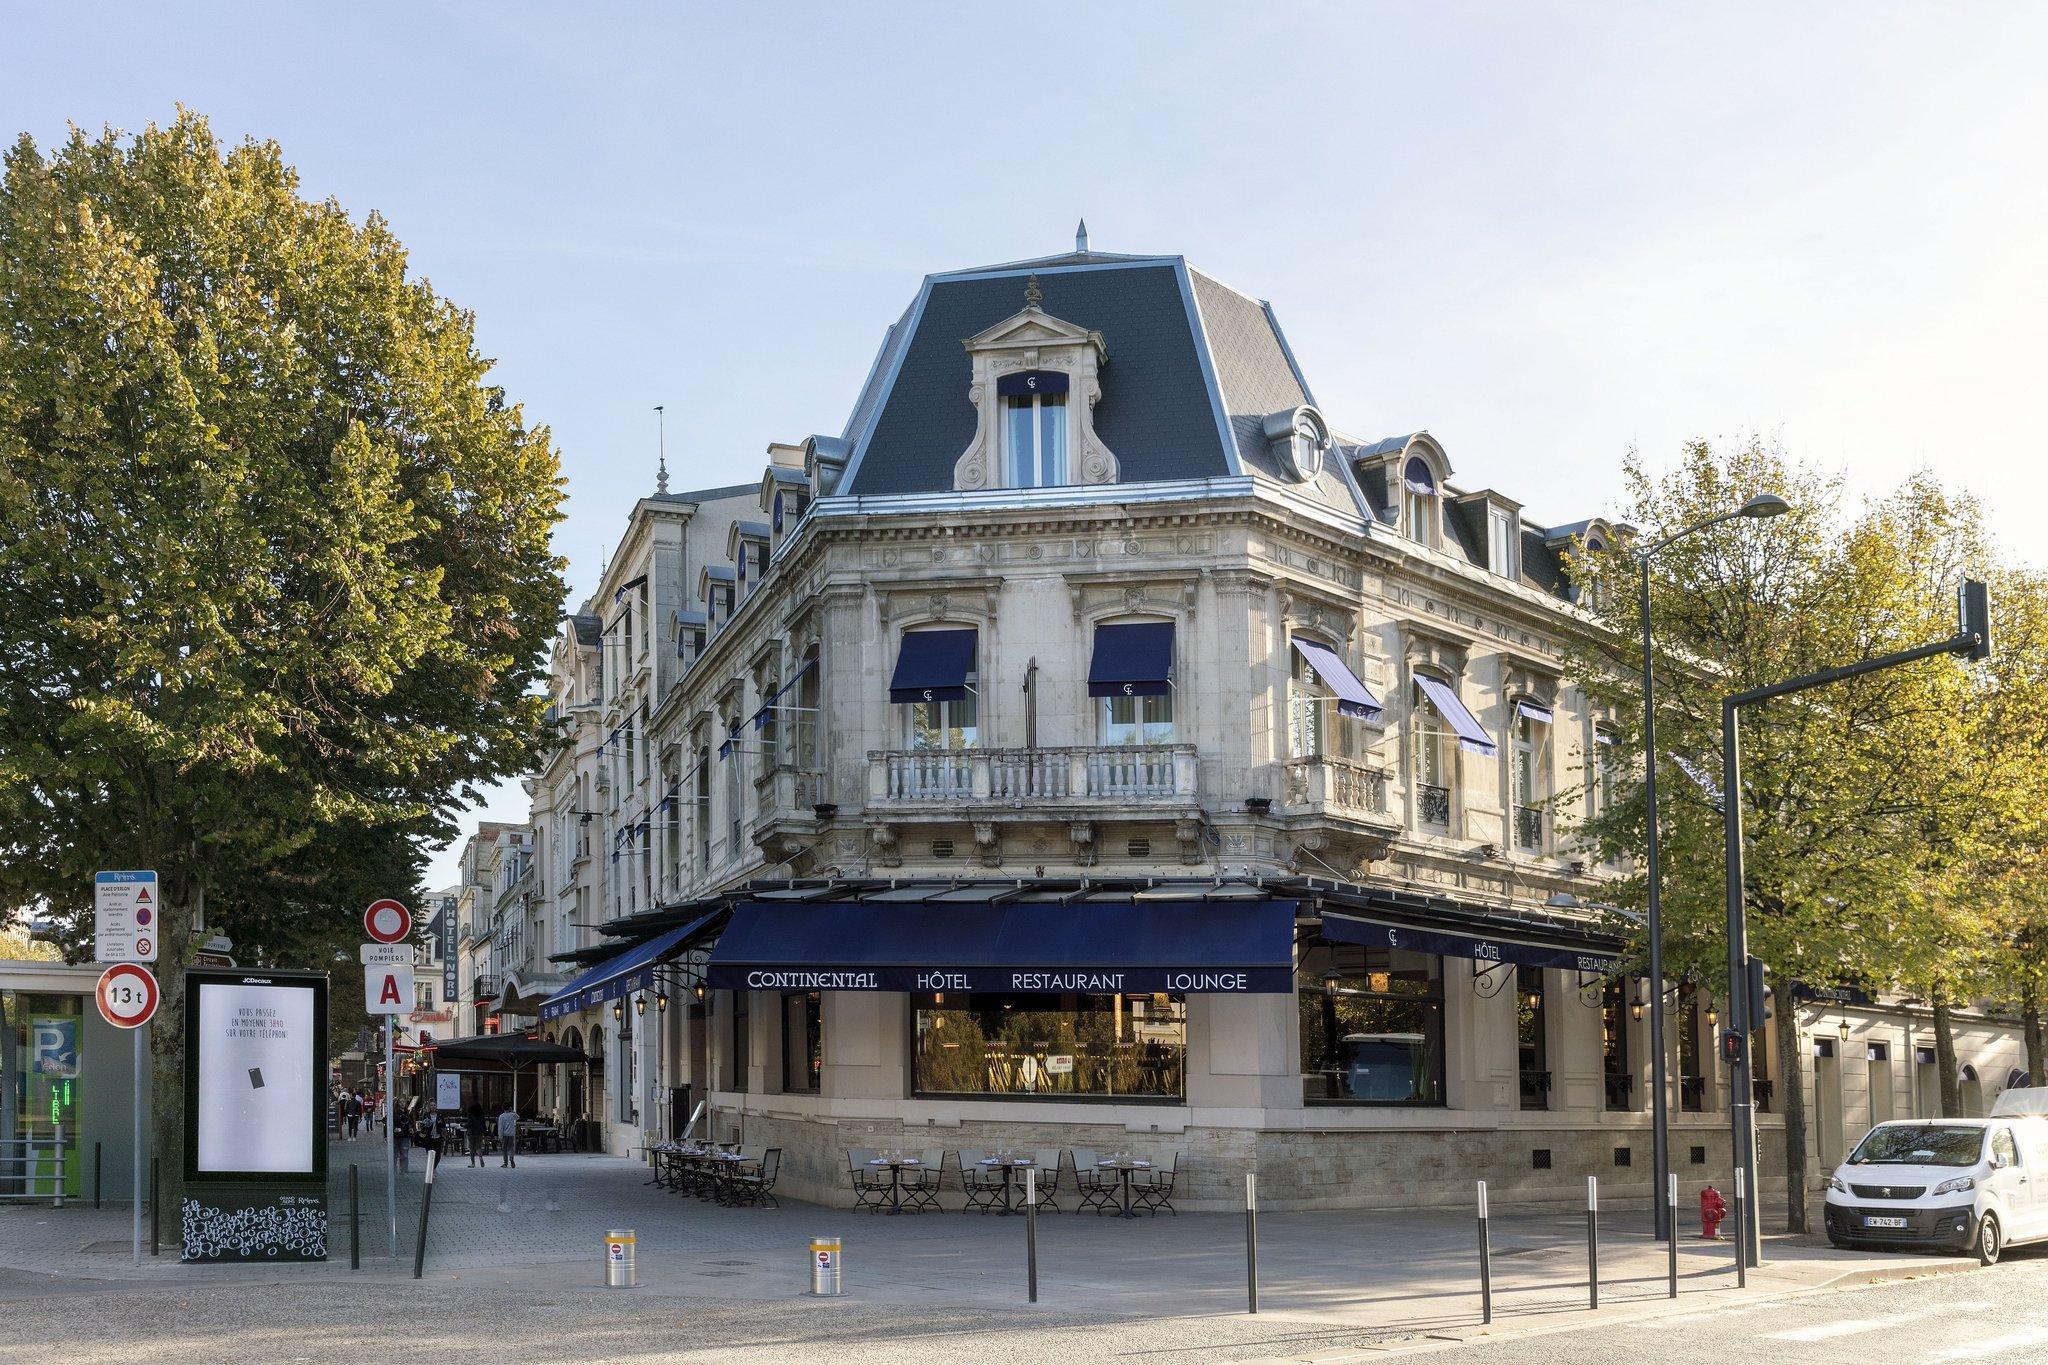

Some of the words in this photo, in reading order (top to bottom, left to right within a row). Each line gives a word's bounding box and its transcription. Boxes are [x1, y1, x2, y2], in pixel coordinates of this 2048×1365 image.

[114, 873, 136, 881] Reims
[1474, 942, 1501, 960] HÔTEL
[446, 963, 456, 998] NORD
[747, 971, 878, 988] CONTINENTAL
[917, 970, 972, 989] HÔTEL
[1012, 973, 1125, 989] RESTAURANT
[1166, 973, 1247, 990] LOUNGE
[111, 987, 131, 1004] 13
[136, 991, 142, 1004] t
[379, 974, 402, 1005] A
[239, 1008, 253, 1017] VOUS
[255, 1008, 276, 1018] PASSEZ
[231, 1018, 239, 1027] EN
[241, 1018, 267, 1028] MOYENNE
[225, 1028, 237, 1038] SUR
[239, 1029, 256, 1038] VOTRE
[34, 1028, 65, 1062] P
[52, 1085, 60, 1125] LIBRE
